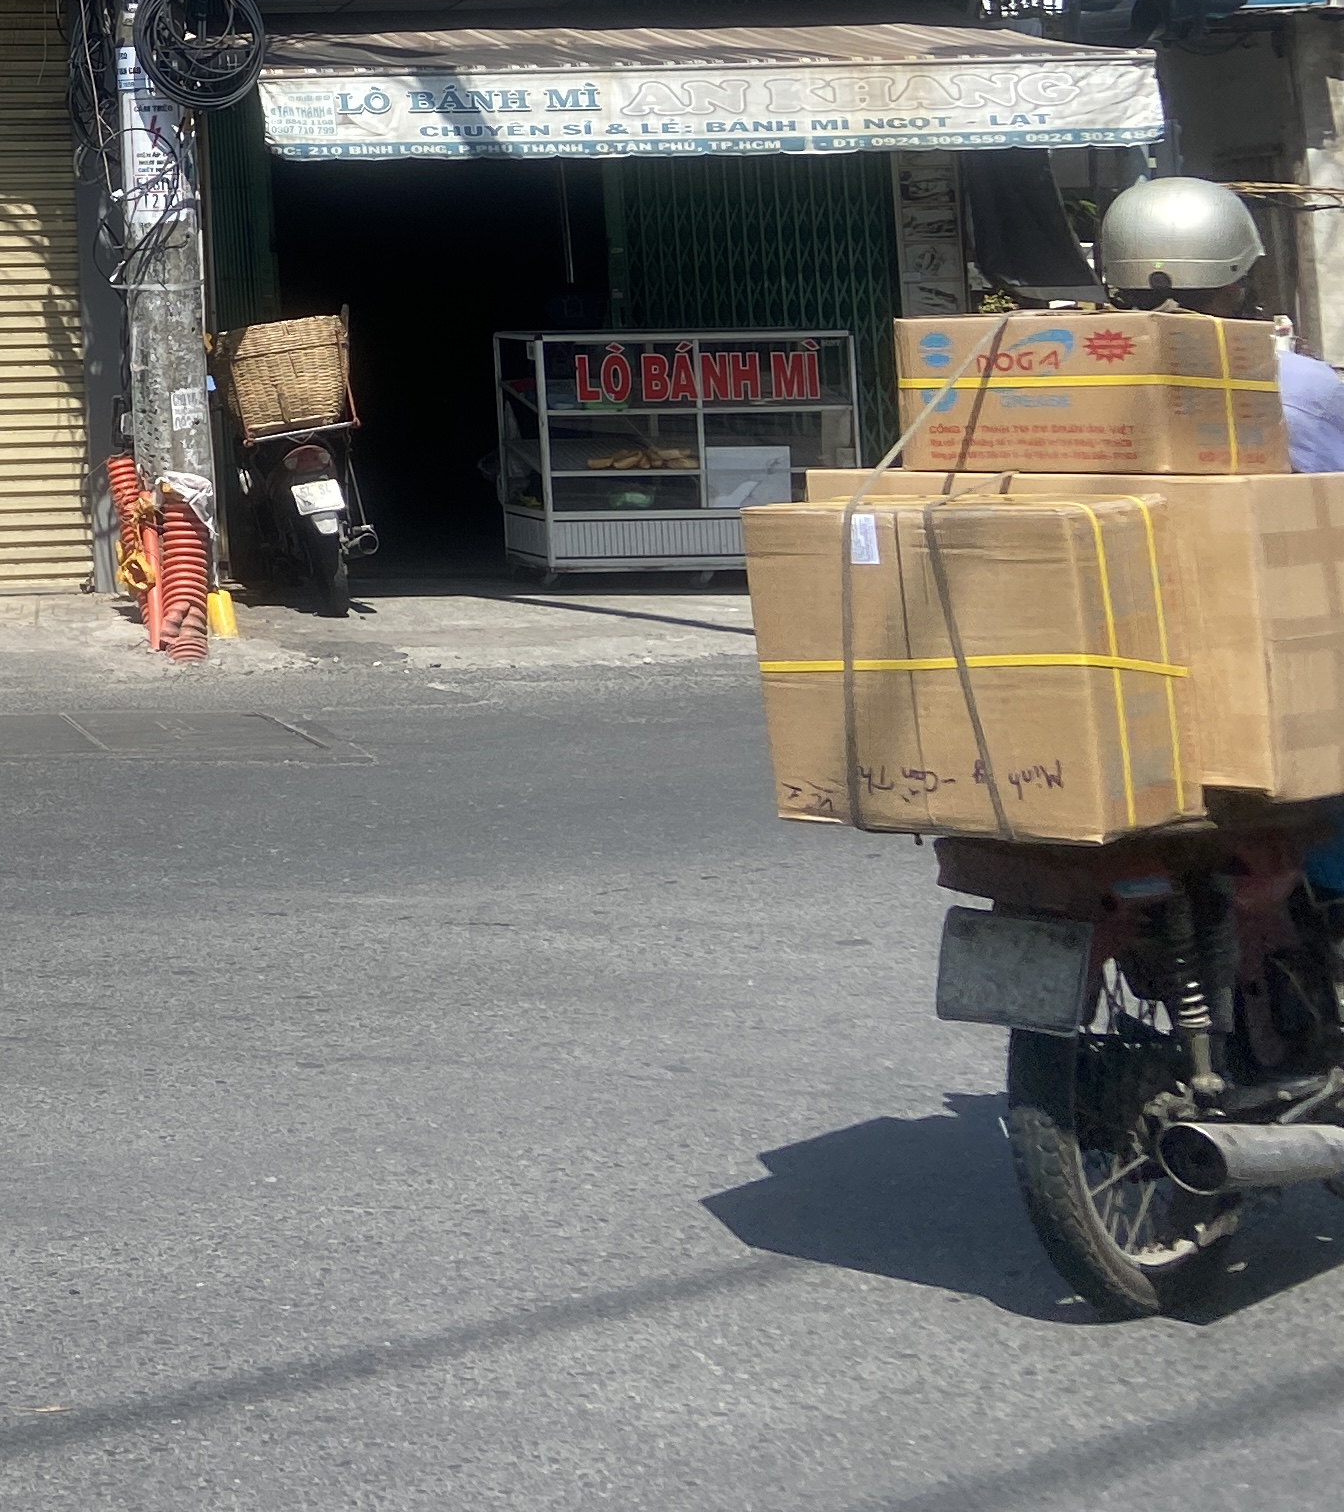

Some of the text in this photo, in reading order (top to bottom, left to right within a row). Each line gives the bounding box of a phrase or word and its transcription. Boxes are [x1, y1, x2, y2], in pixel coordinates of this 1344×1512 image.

[336, 72, 1080, 117] LÒ BÁNH MÌ AN KHANG
[419, 113, 1052, 138] CHUYÊN SỈ & LẺ: BÁNH MÌ NGỌT LẠT
[308, 146, 343, 156] 210
[349, 142, 395, 155] BÌNH
[400, 144, 452, 156] LONG,
[519, 143, 590, 156] THẠNH,
[658, 139, 702, 152] PHÚ,
[708, 139, 781, 150] TP.HCM
[871, 134, 1006, 147] 0924.309.559
[1026, 133, 1072, 143] 0924
[1080, 131, 1114, 141] 302
[575, 338, 822, 403] LÒ BÁNH MÌ
